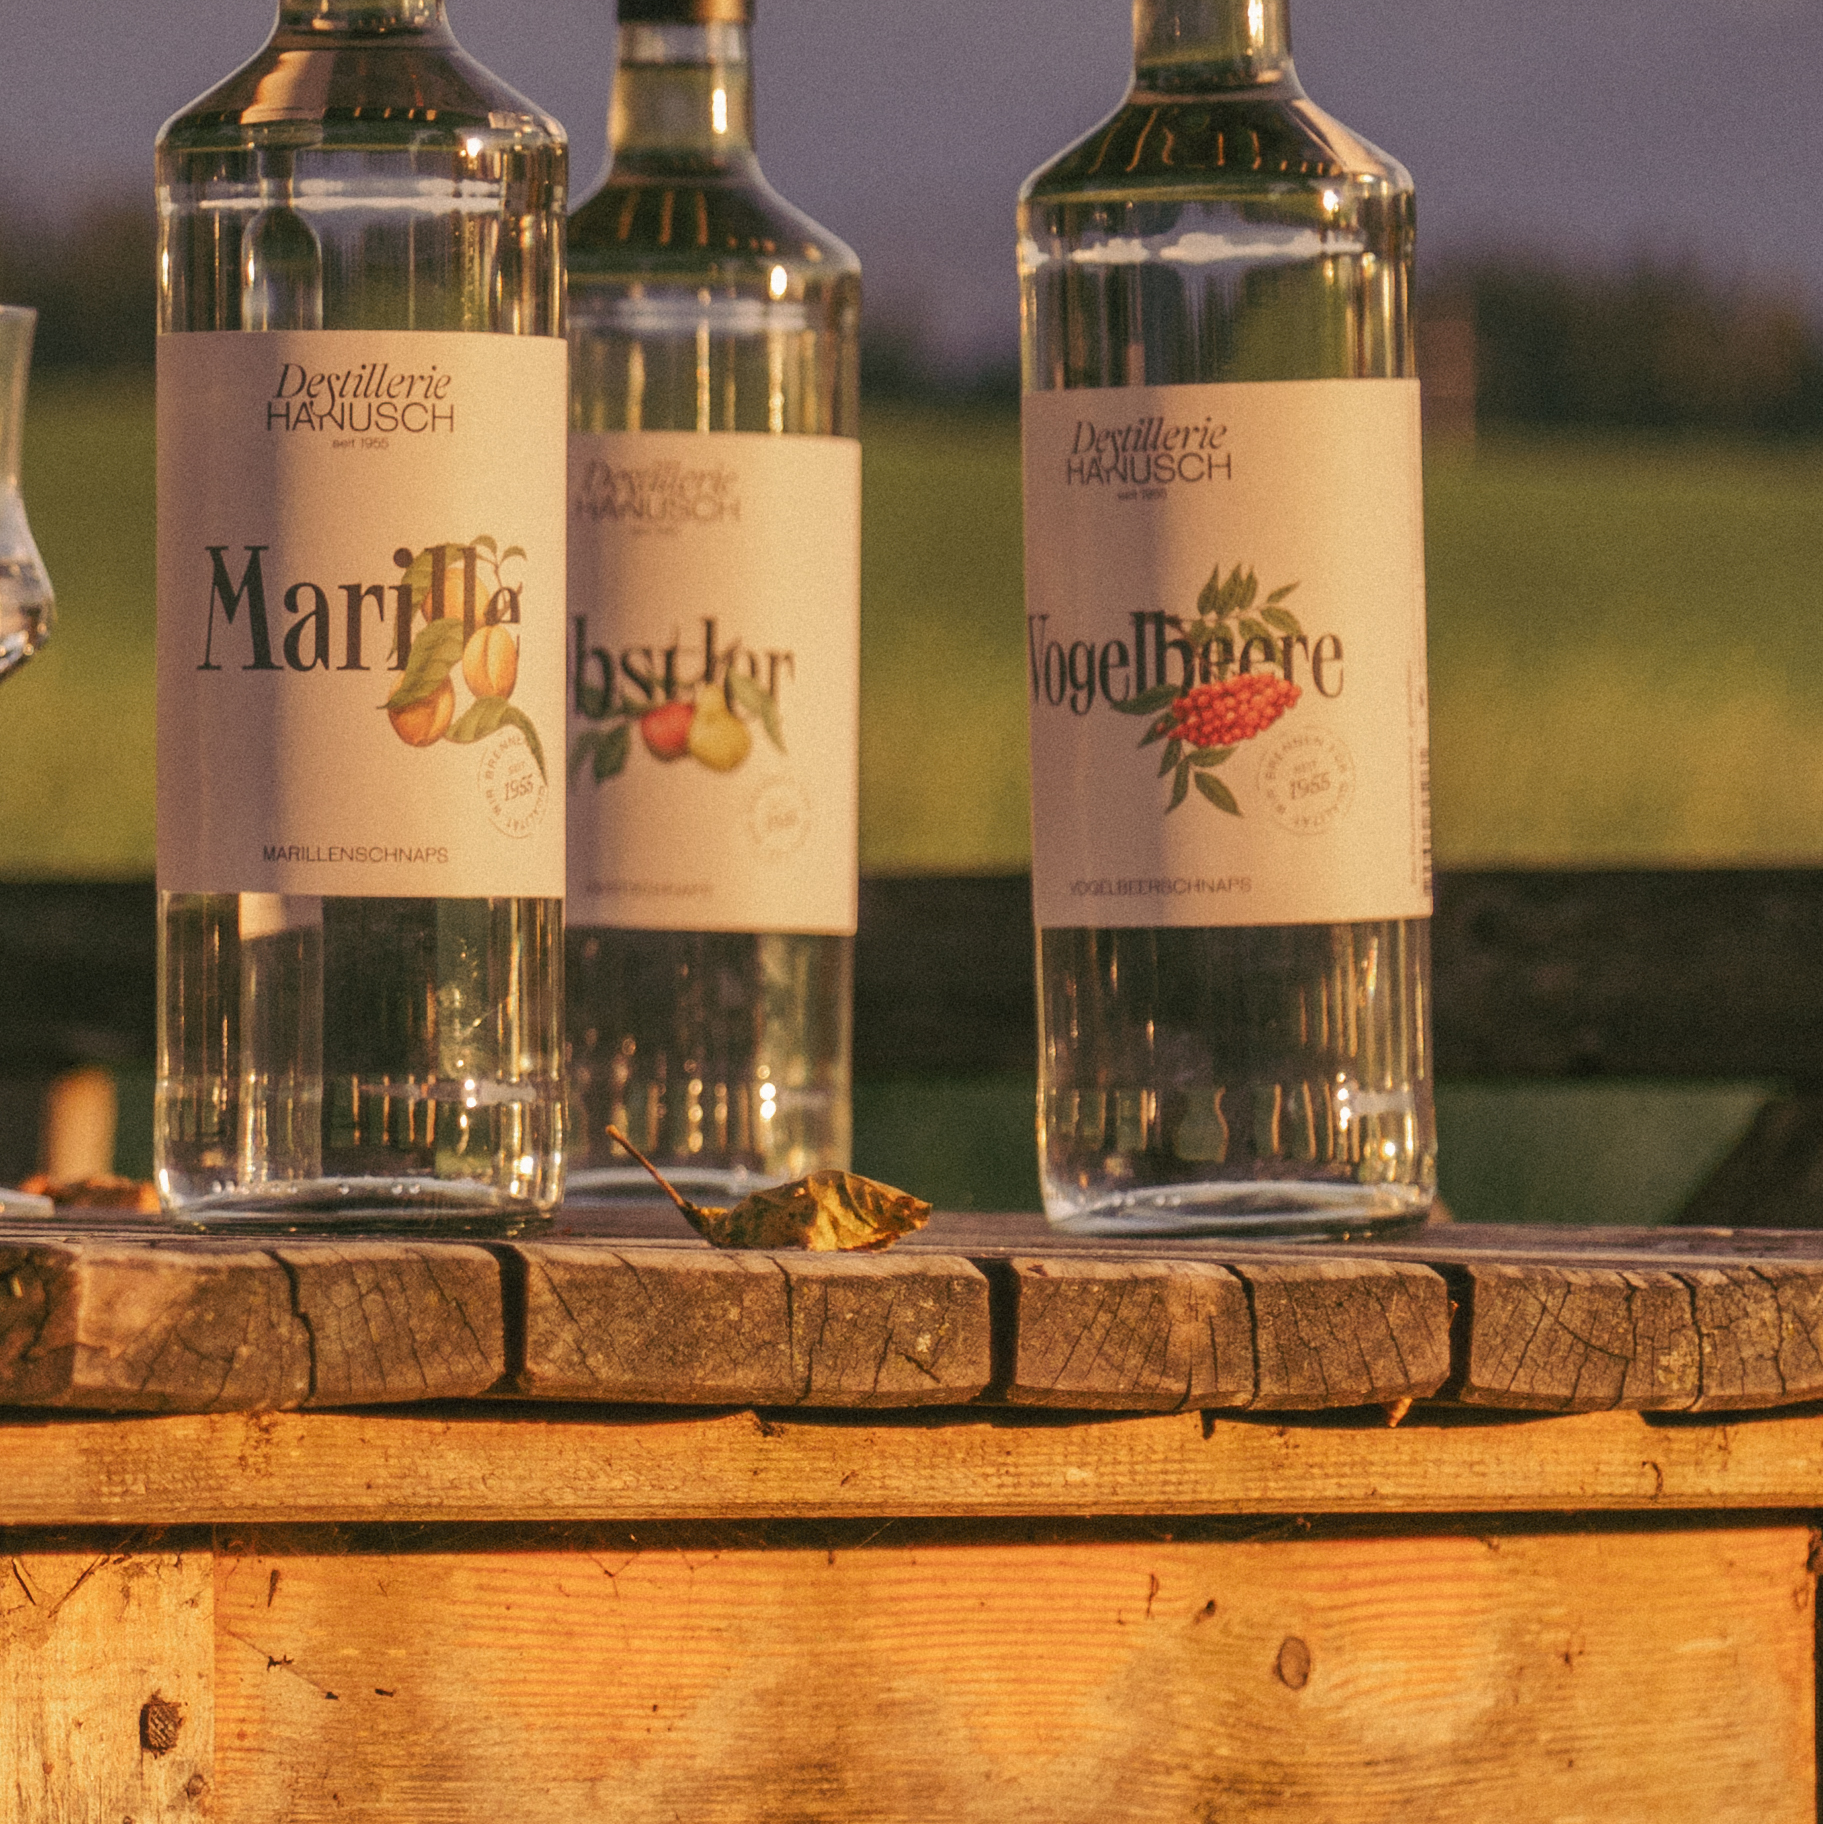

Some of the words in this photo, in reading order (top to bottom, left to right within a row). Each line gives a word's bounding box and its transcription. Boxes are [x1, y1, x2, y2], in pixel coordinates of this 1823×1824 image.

[271, 362, 453, 417] Destillerie
[264, 400, 455, 434] HANUSCH
[1071, 415, 1229, 466] Destillerie
[1066, 451, 1233, 486] HANUSCH
[261, 844, 449, 864] MARILLENSCHNAPS
